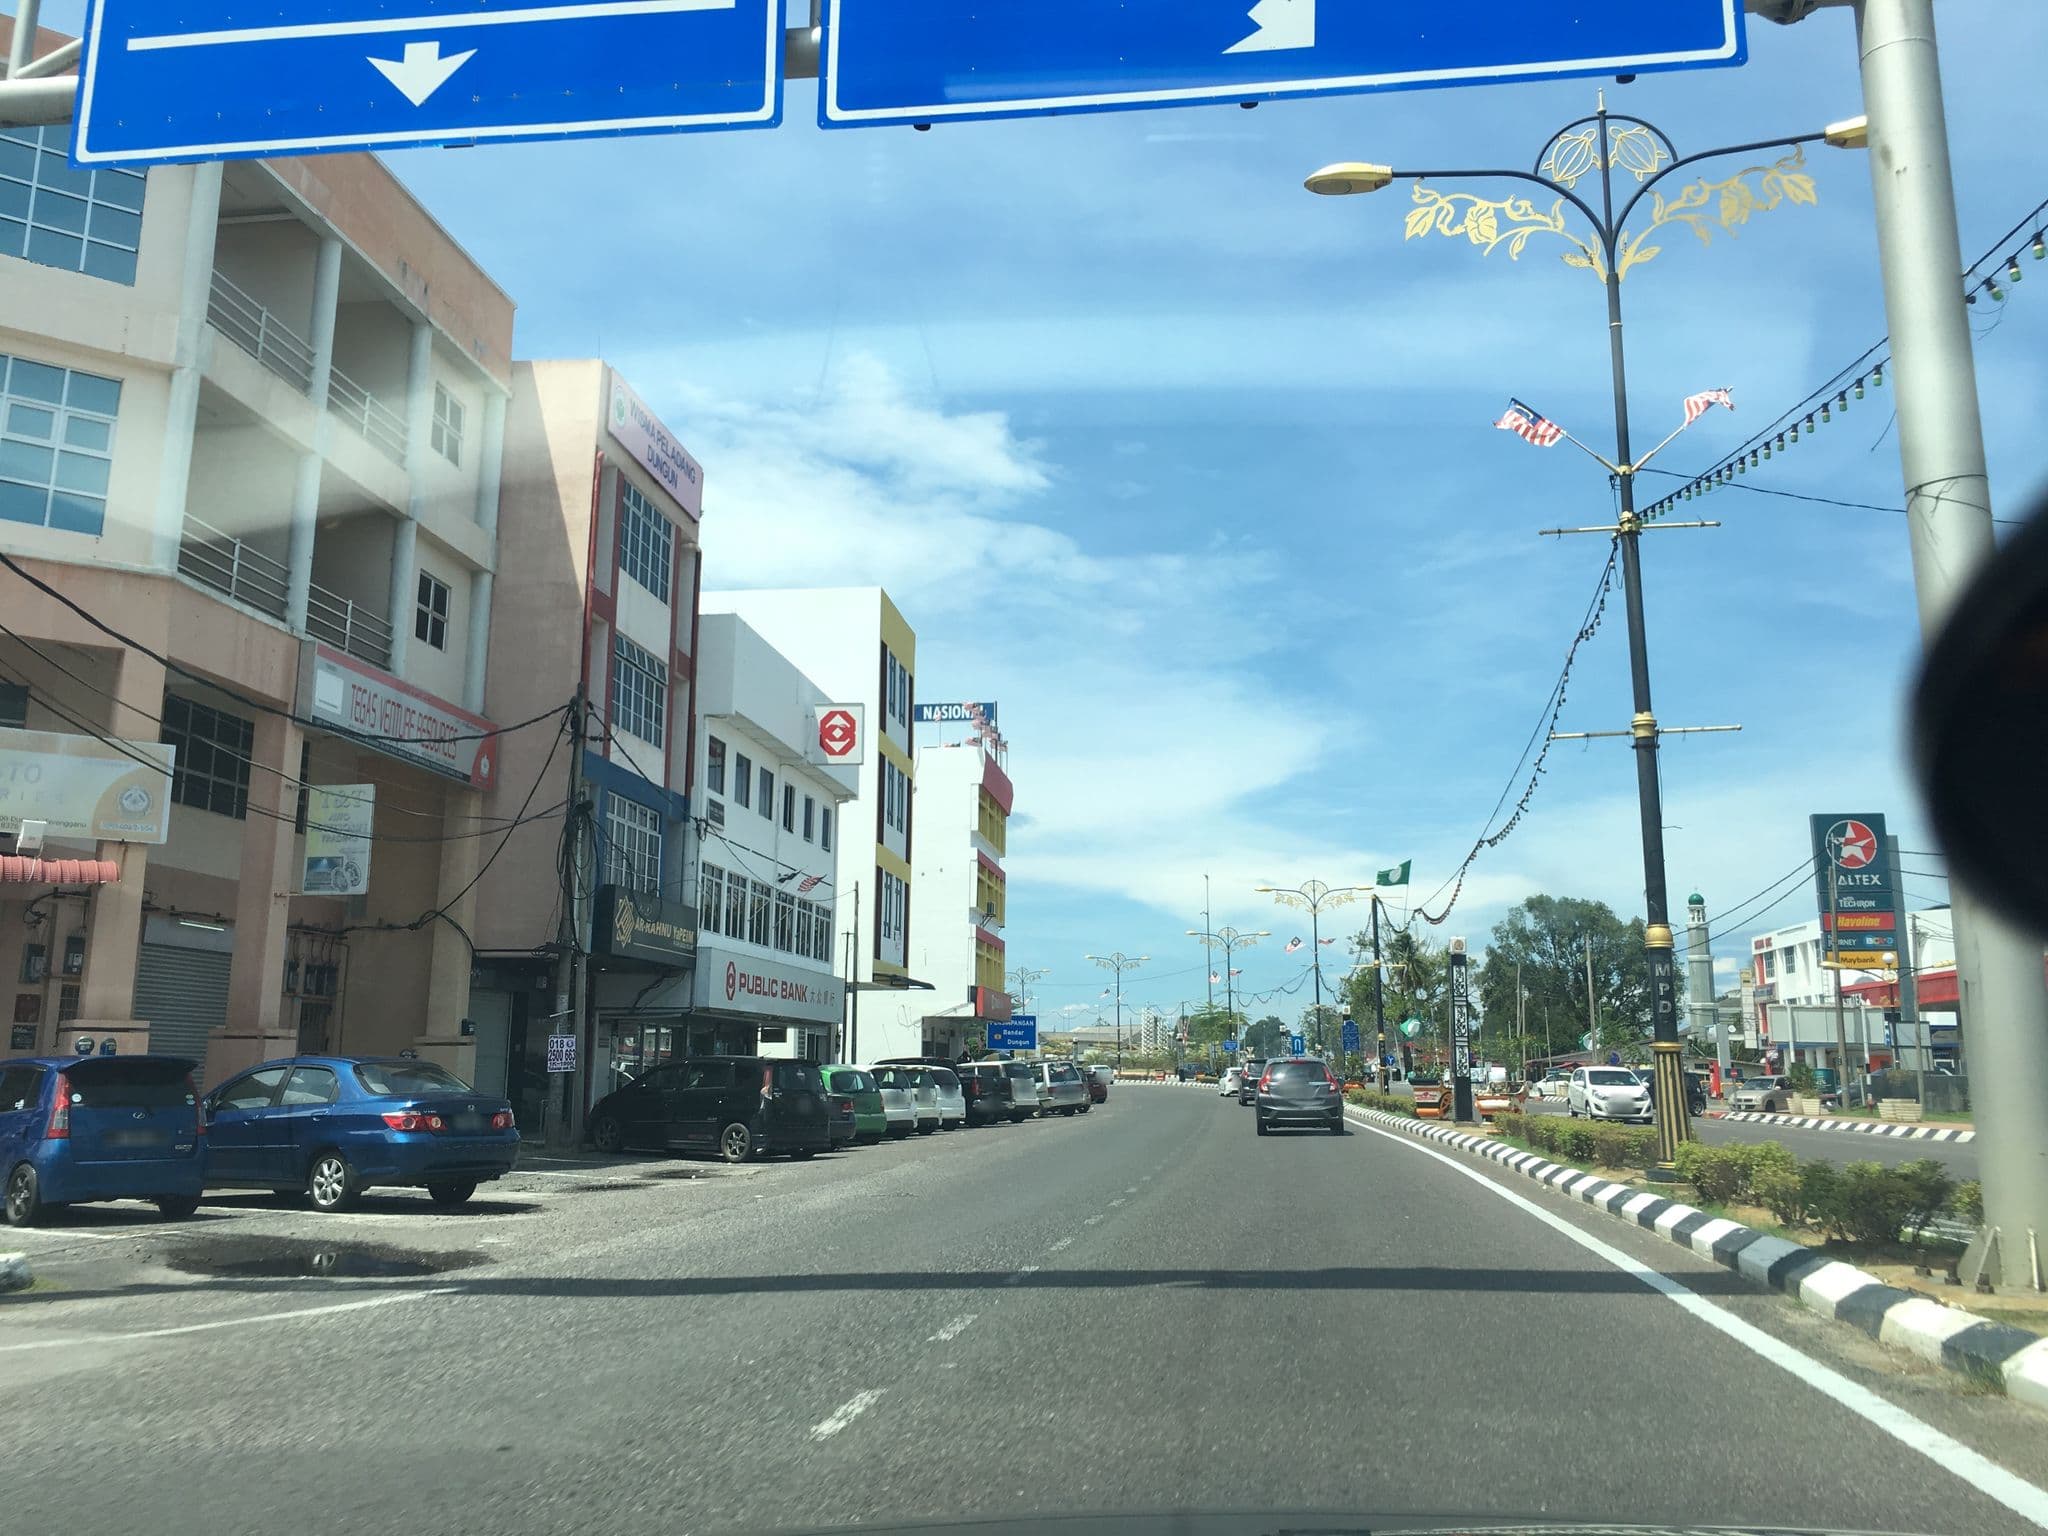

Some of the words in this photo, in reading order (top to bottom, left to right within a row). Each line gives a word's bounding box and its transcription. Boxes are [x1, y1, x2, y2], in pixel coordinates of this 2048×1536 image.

[630, 398, 656, 438] WISMA
[656, 429, 697, 485] PELADANG
[647, 445, 678, 489] DUNGUN
[352, 684, 378, 729] TEGAS
[1829, 874, 1882, 886] ALTEX
[1839, 899, 1876, 908] TECHRON
[1837, 915, 1881, 927] Havoline
[1840, 956, 1876, 965] Maybank
[739, 972, 778, 998] PUBLIC
[781, 980, 808, 1003] BANK
[549, 1039, 565, 1049] 018
